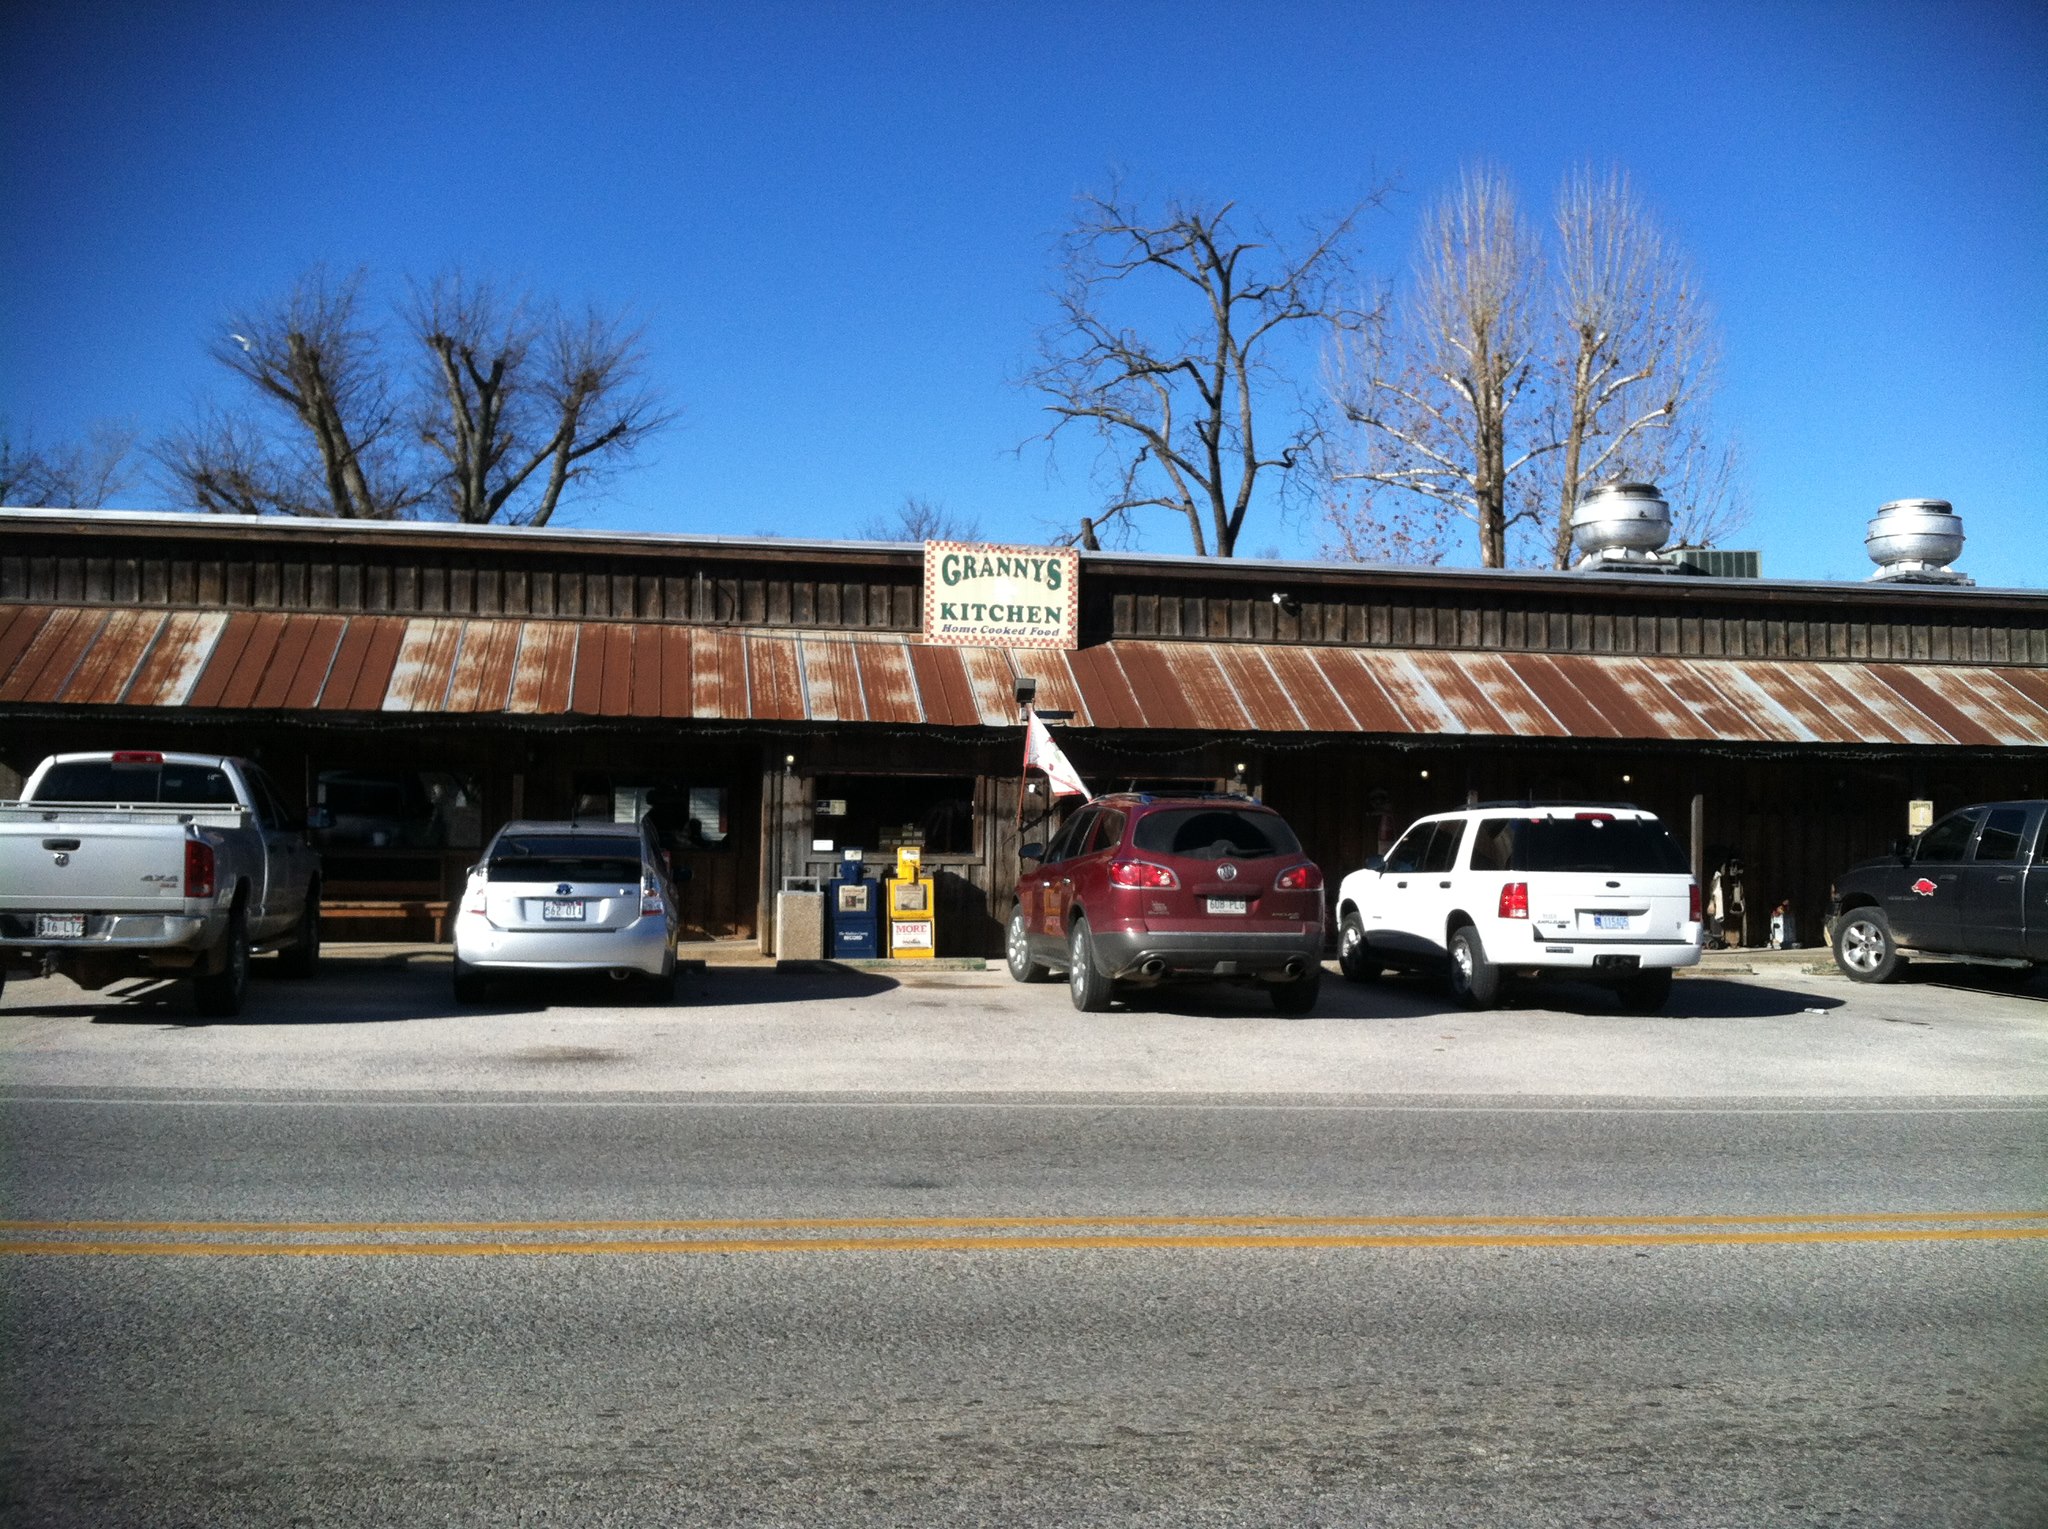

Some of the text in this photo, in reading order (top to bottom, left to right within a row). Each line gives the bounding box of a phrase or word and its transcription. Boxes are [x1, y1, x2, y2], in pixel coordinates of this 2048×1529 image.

[940, 602, 1062, 624] KITCHEN
[942, 624, 1060, 637] Home Cooked Food
[895, 924, 928, 934] MORE
